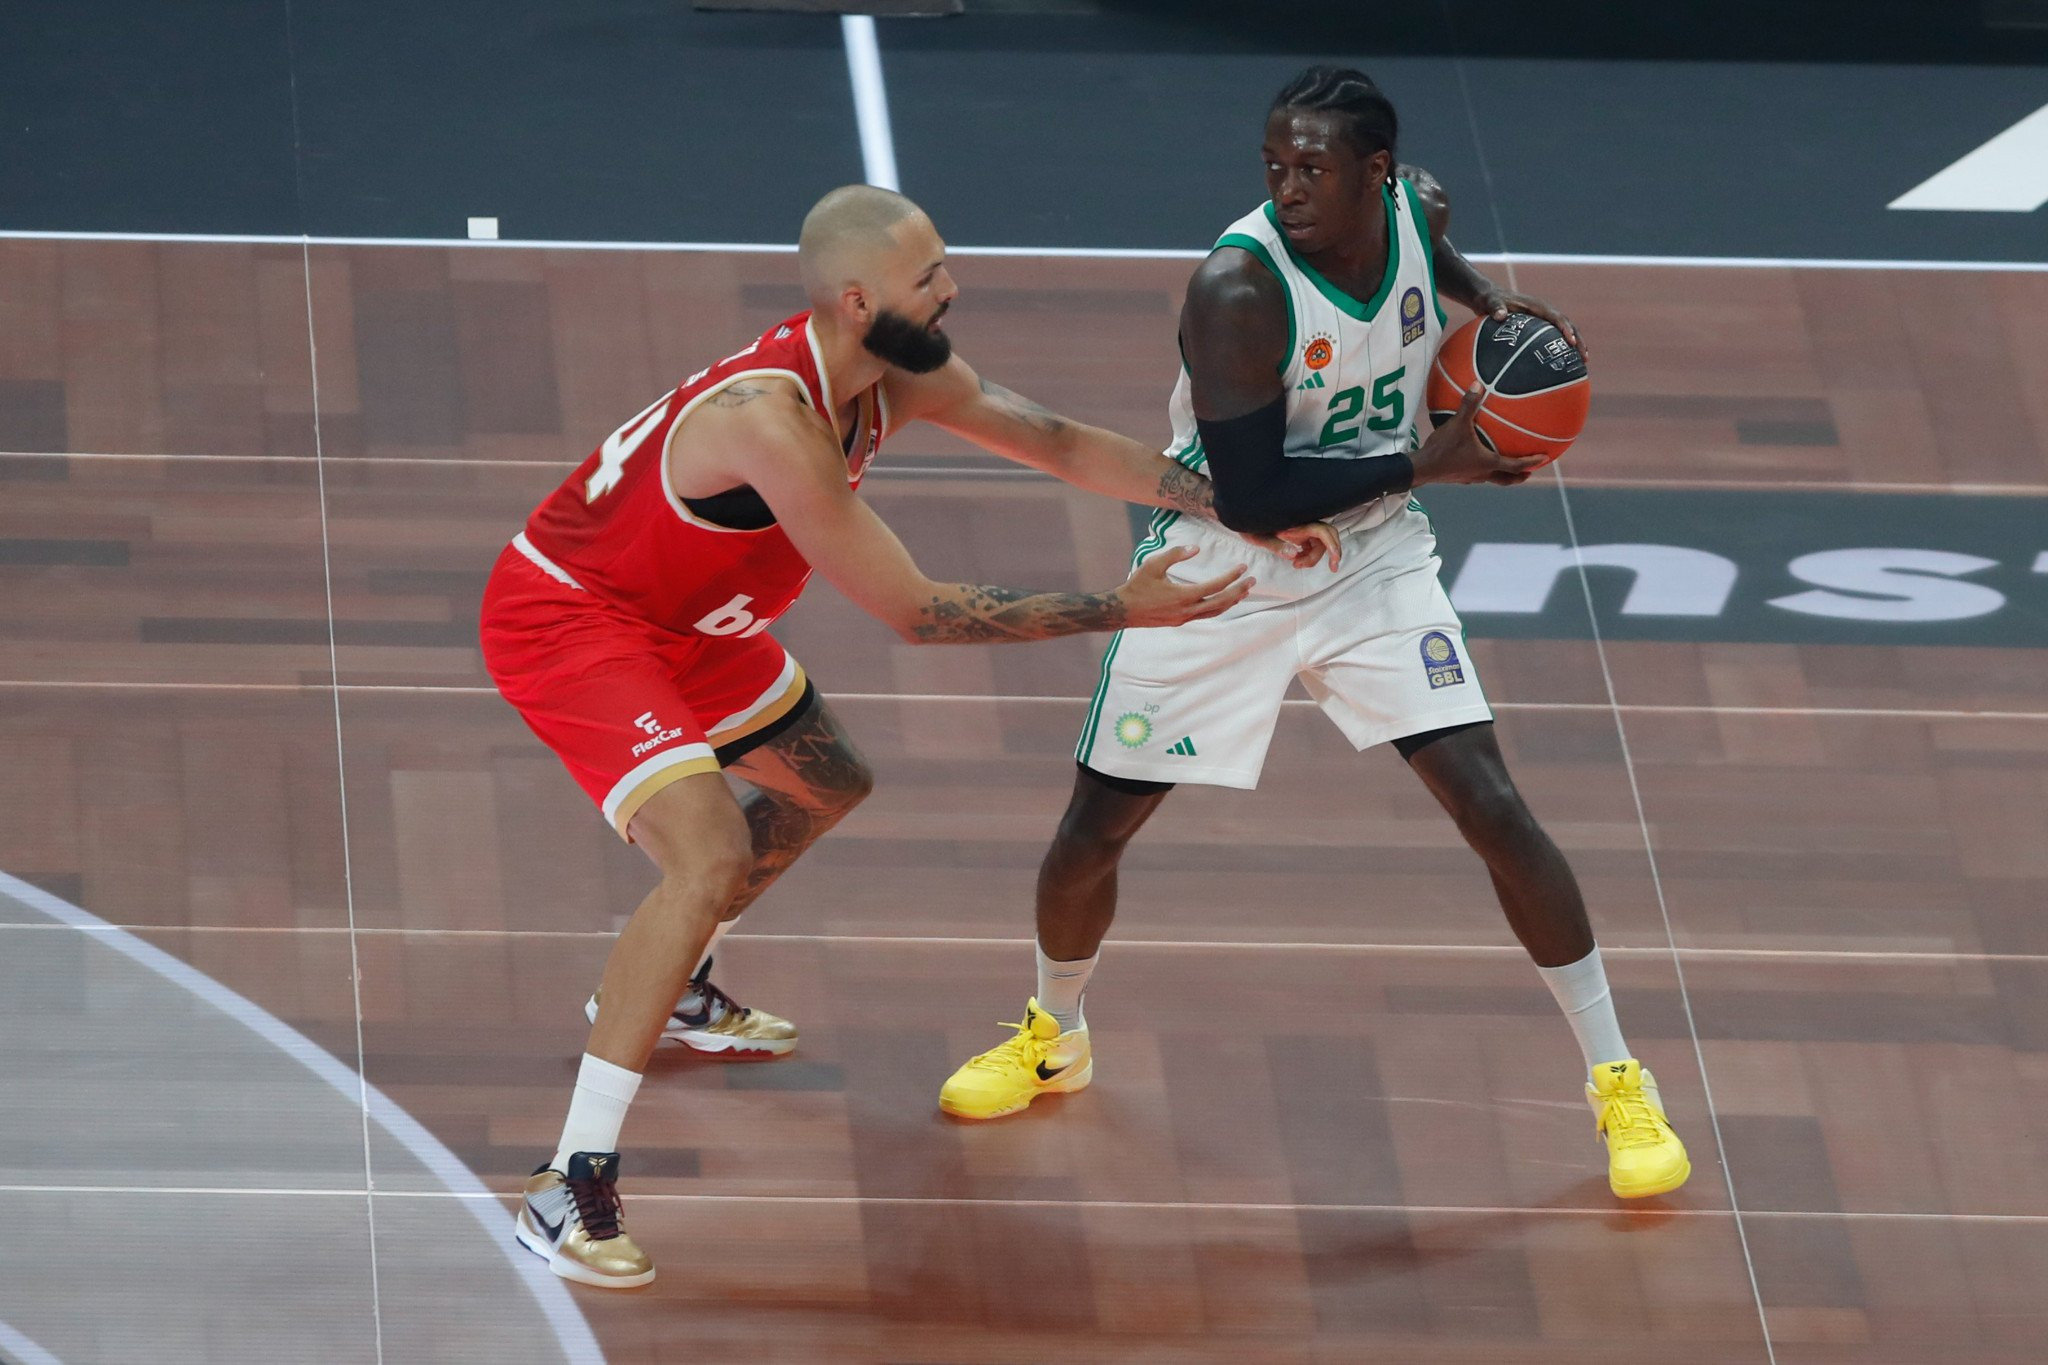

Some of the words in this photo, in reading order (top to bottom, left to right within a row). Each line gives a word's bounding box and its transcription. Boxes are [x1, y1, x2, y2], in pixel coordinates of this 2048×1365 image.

[1403, 326, 1424, 344] GBL
[1319, 365, 1406, 447] 25
[1447, 541, 2048, 621] ns
[1431, 670, 1463, 687] GBL
[1144, 702, 1160, 714] bp
[631, 727, 683, 758] FlexCar
